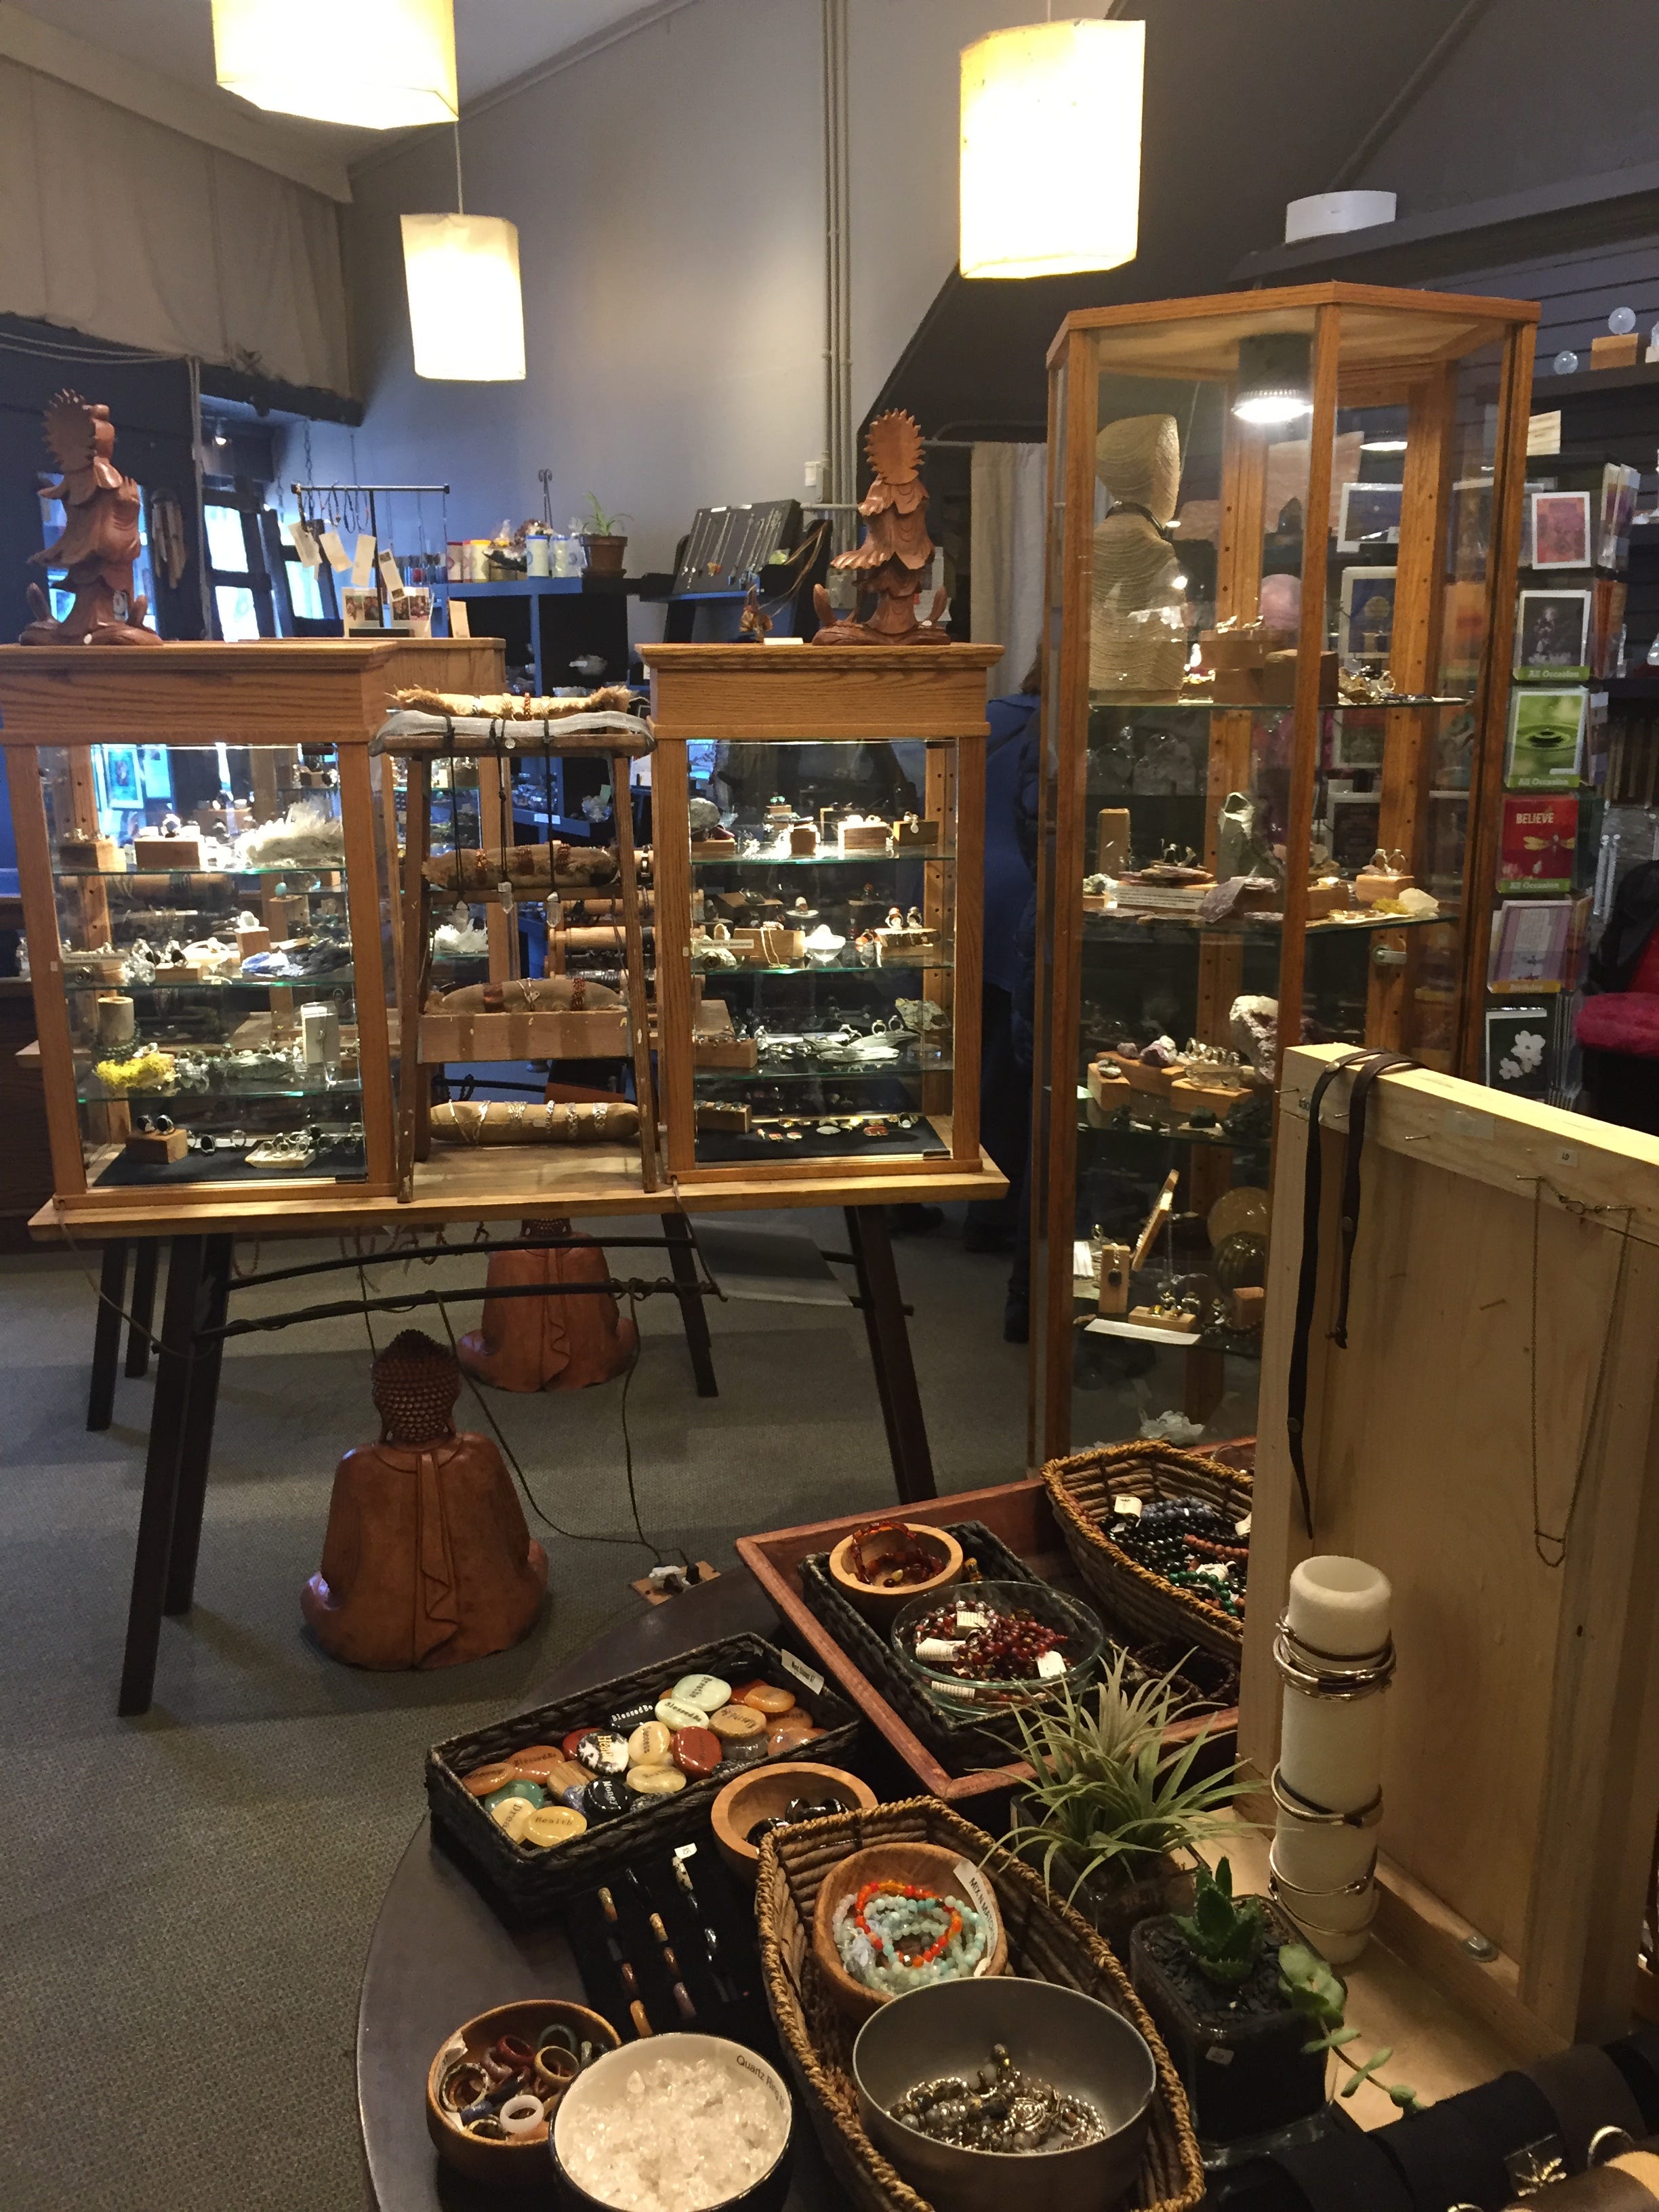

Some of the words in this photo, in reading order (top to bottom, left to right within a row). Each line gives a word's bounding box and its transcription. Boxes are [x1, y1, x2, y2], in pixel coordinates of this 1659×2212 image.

[1516, 813, 1554, 824] BELIEVE
[689, 1677, 713, 1698] Breathe
[602, 1781, 618, 1805] Money
[535, 1816, 573, 1826] Health
[968, 1877, 981, 1896] MIX
[977, 1893, 984, 1905] N
[737, 2055, 764, 2081] Quartz
